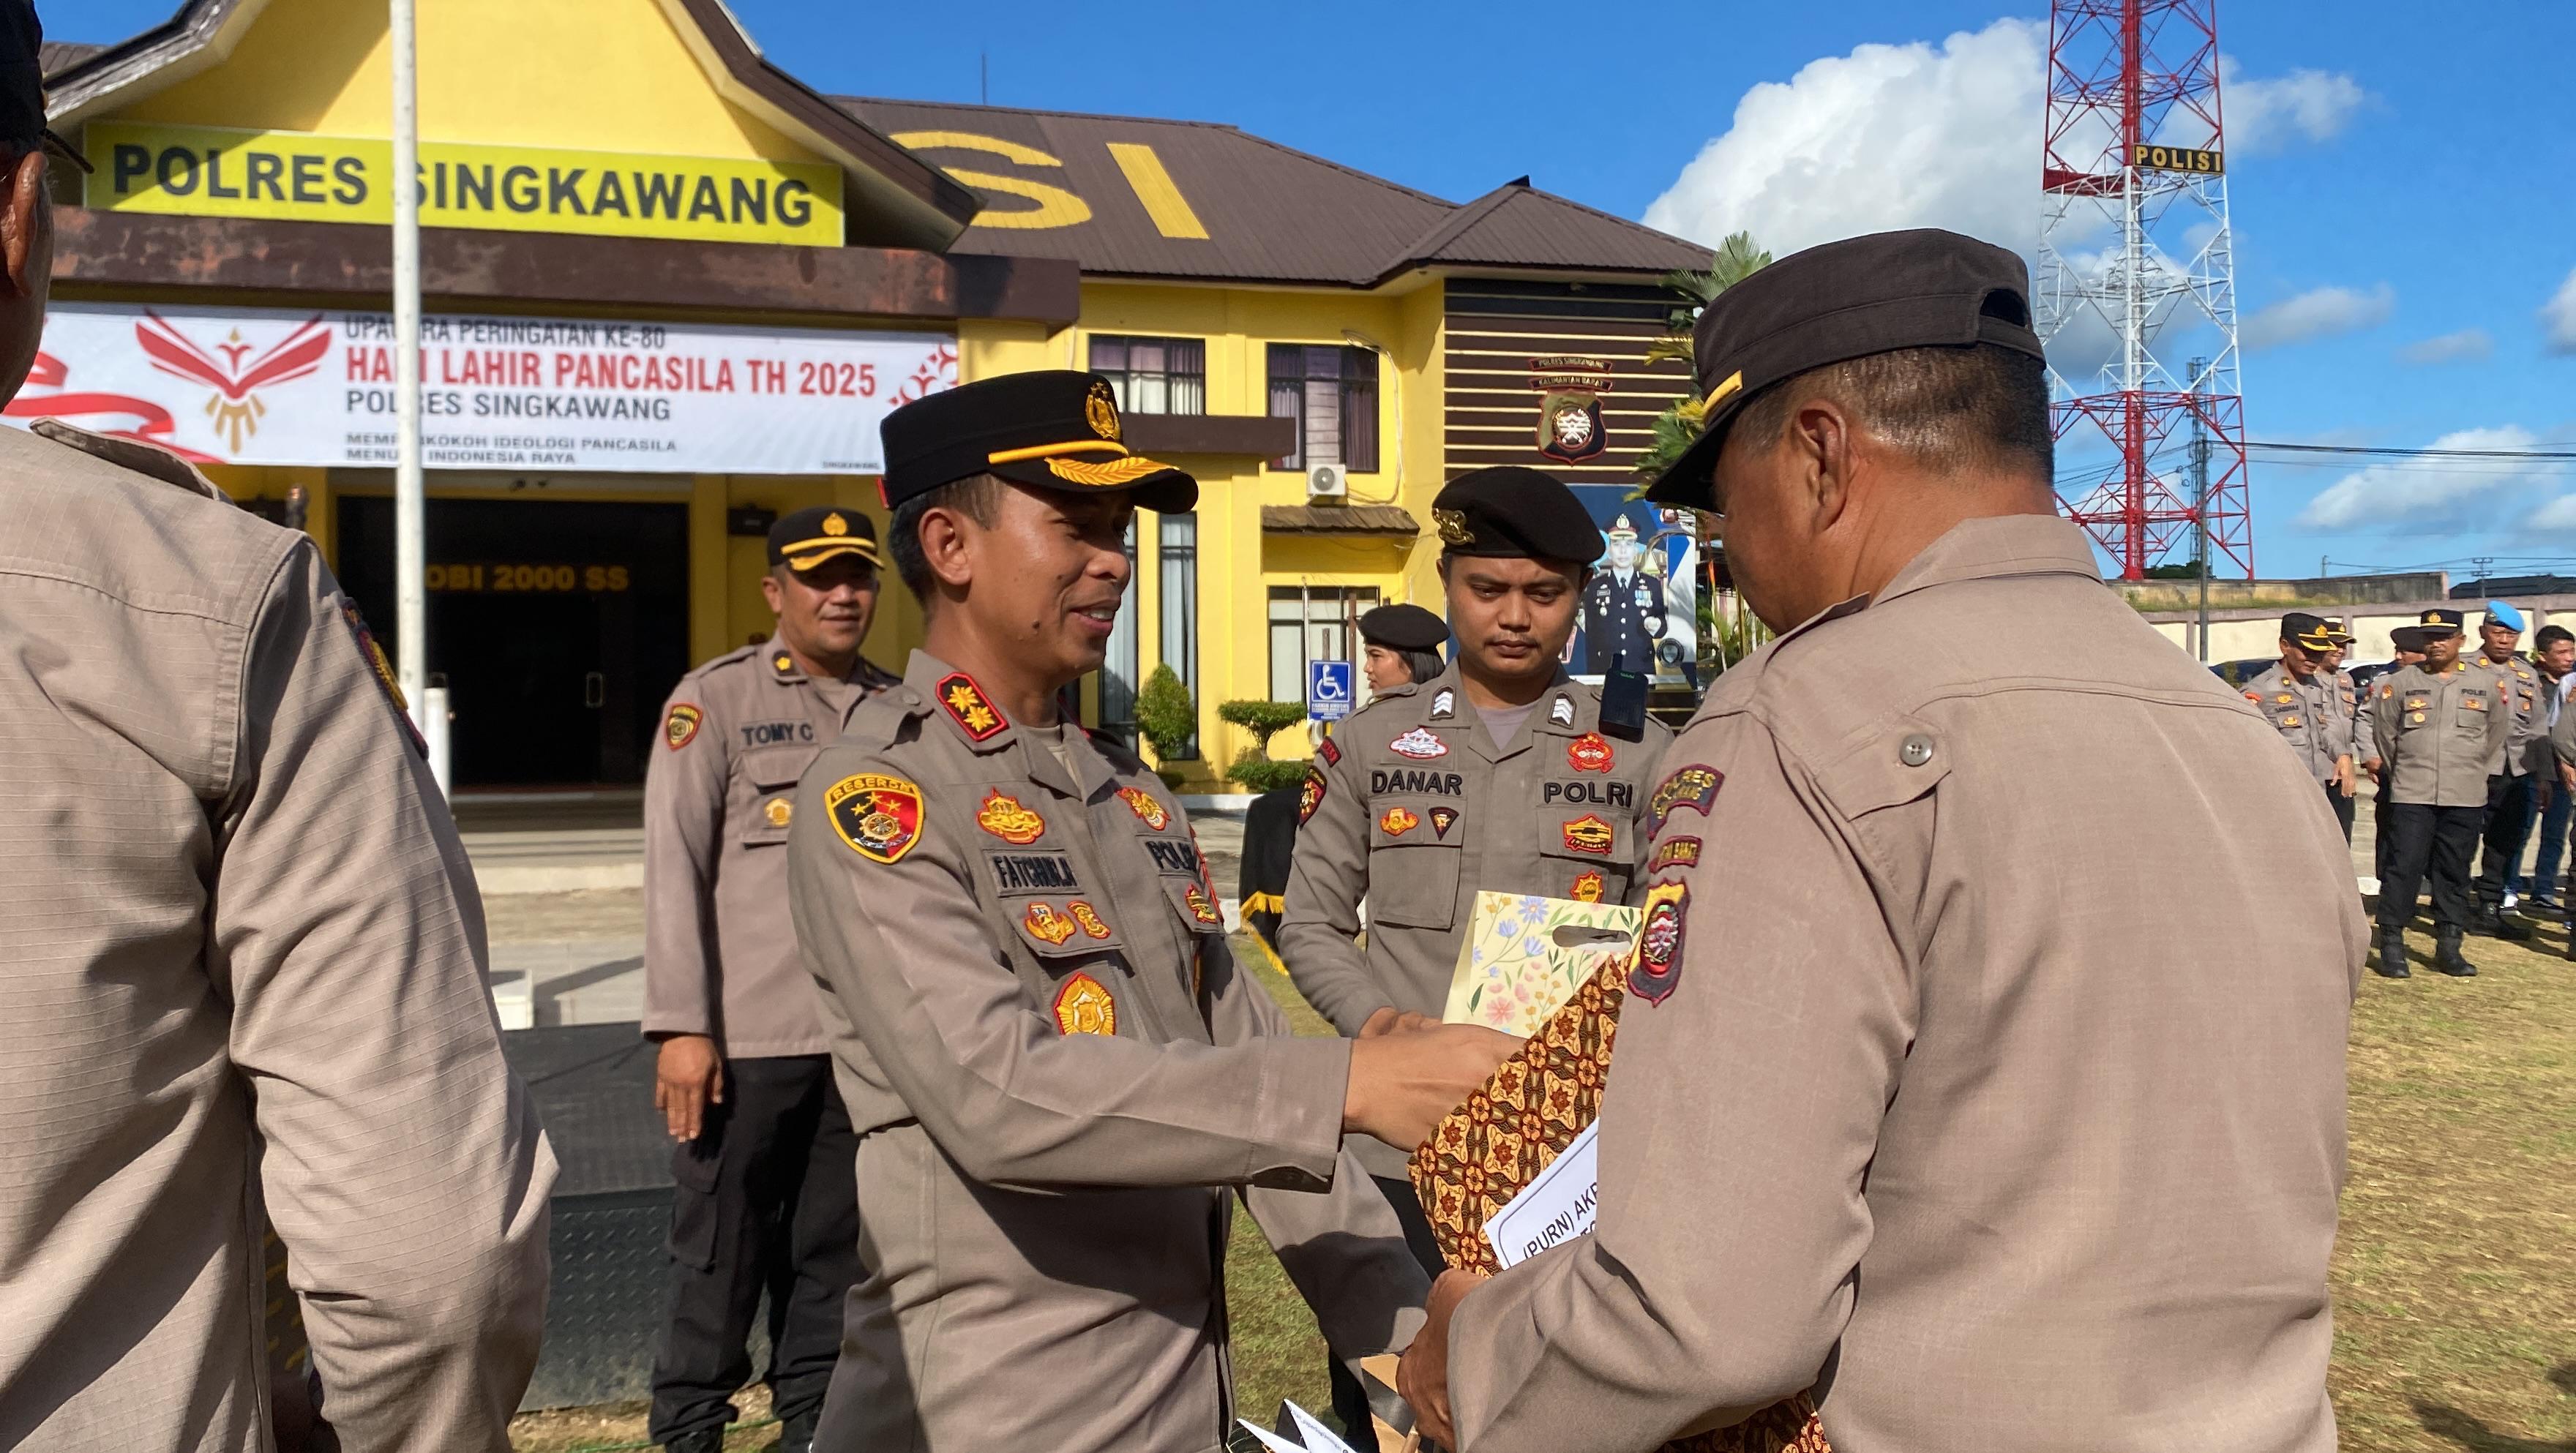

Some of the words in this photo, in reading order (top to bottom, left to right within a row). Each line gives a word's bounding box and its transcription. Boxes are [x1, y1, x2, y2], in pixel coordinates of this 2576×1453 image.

[2135, 146, 2222, 172] POLISI
[113, 143, 367, 206] POLRES
[345, 315, 452, 342] UPARA
[460, 320, 596, 346] PERINGATAN
[604, 324, 666, 349] KE-80
[347, 346, 427, 383] HAI
[441, 350, 542, 386] LAHIR
[555, 353, 735, 394] PANCASILA
[746, 359, 786, 394] TH
[798, 362, 876, 397] 2025
[347, 390, 463, 415] POLES
[474, 394, 670, 421] SINGKAWANG
[346, 448, 398, 459] MENU
[428, 451, 525, 463] INDONESIA
[532, 452, 575, 464] RAYA
[493, 438, 574, 449] IDEOLOGI
[581, 439, 678, 452] PANCASILA
[425, 564, 484, 591] OBI
[493, 565, 576, 591] 2000
[585, 566, 629, 591] SS
[741, 722, 795, 746] TOMY
[800, 723, 814, 741] C
[1371, 769, 1463, 796] DANAR
[1545, 781, 1633, 808] POLRI
[1523, 1210, 1575, 1259] (PURN)
